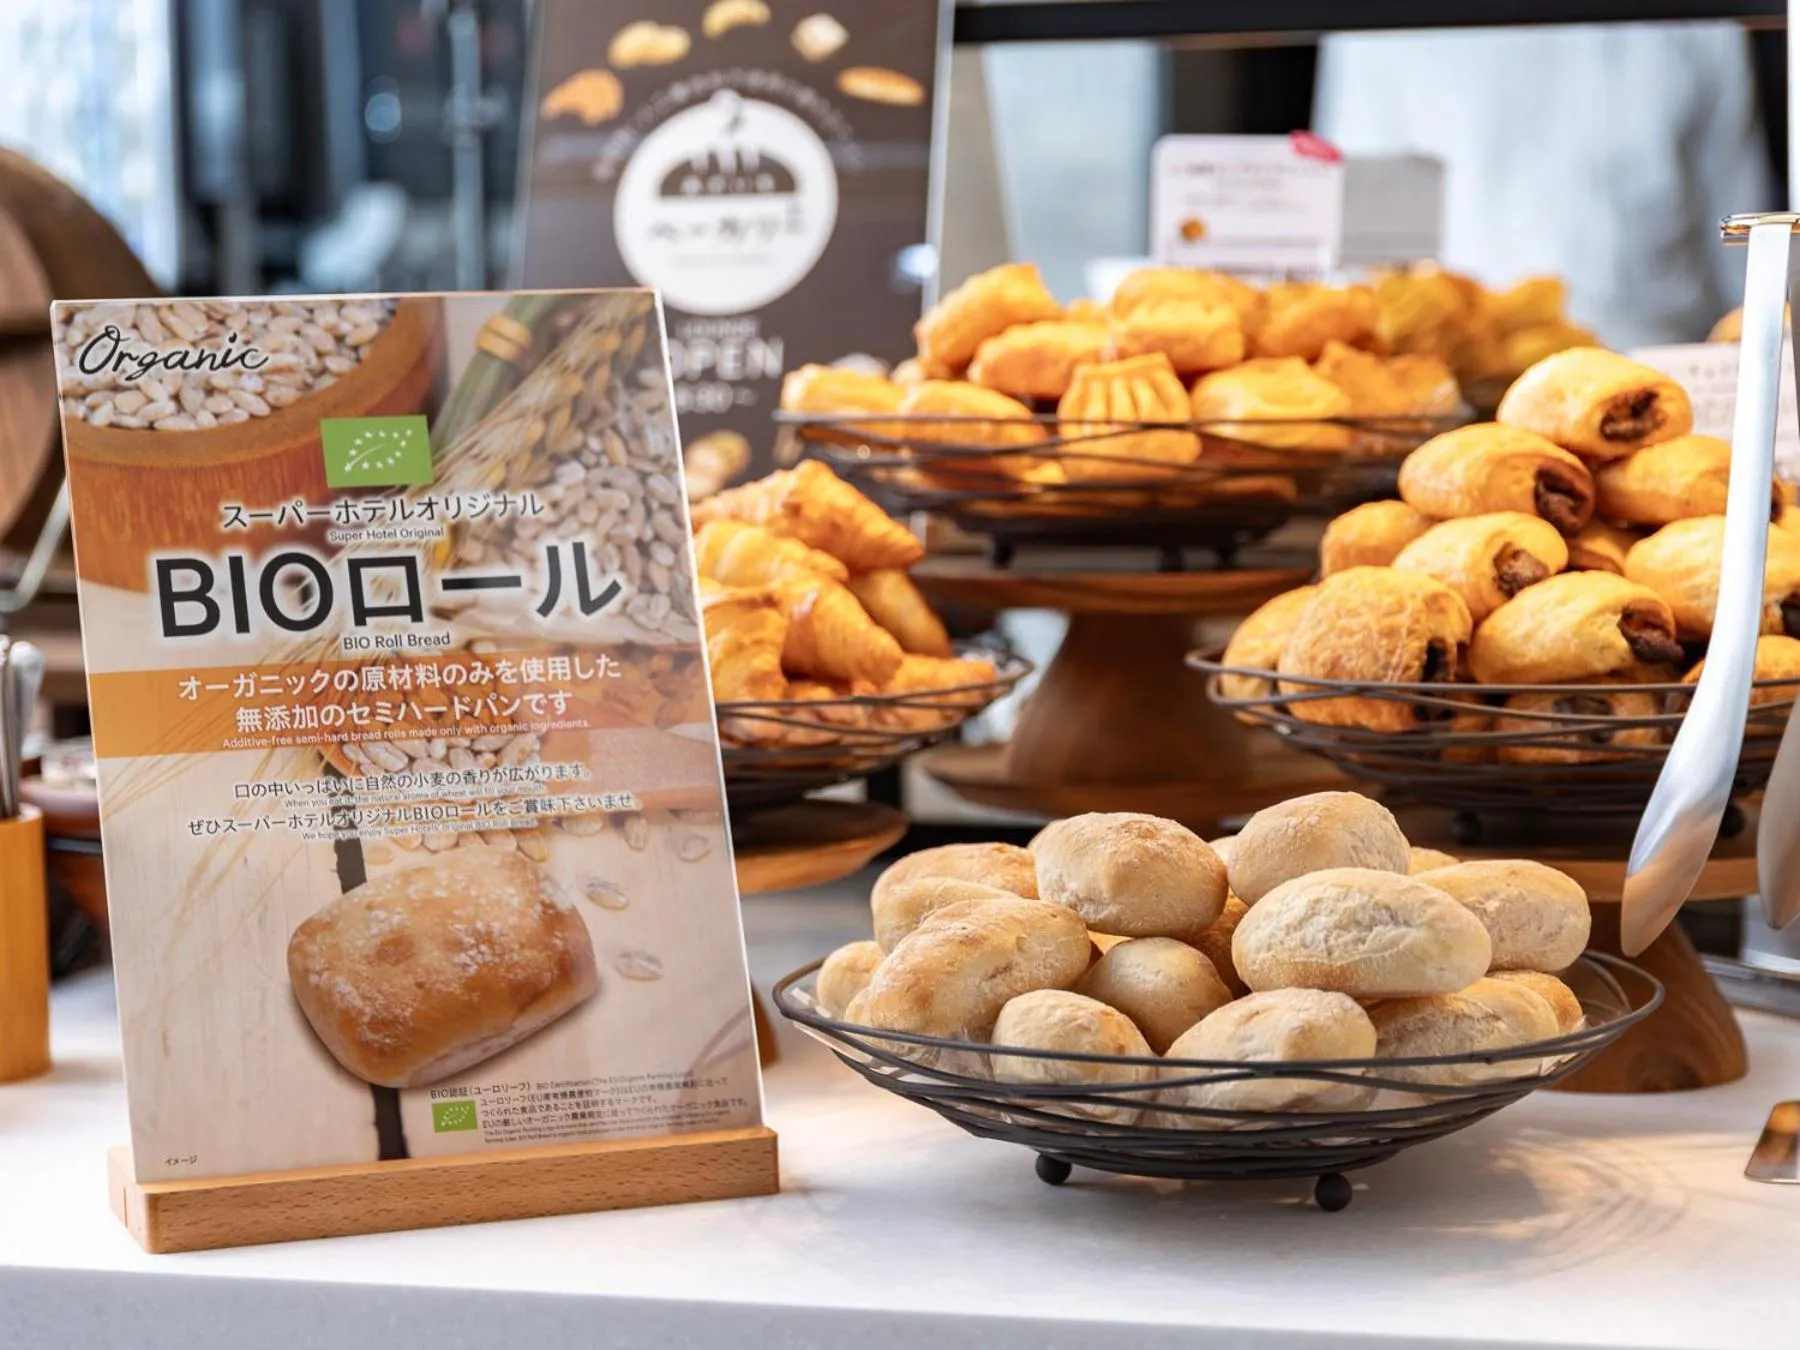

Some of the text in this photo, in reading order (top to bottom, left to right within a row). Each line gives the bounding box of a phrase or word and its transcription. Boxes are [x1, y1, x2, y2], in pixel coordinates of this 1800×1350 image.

[79, 325, 268, 381] Organic
[223, 493, 545, 528] スーパーホテルオリジナル
[330, 526, 445, 542] Super Hotel Original
[156, 541, 622, 637] BIOロール
[344, 633, 450, 649] BIO Roll Bread
[179, 653, 622, 701] オーガニックの原材料のみを使用した
[236, 690, 573, 733] 無添加のセミハードパンです
[223, 735, 293, 749] Additive-free
[295, 732, 348, 744] semi-hard
[351, 730, 381, 742] bread
[384, 729, 406, 739] rolls
[409, 727, 437, 737] made
[440, 725, 461, 737] only
[464, 723, 487, 734] with
[490, 722, 528, 735] organic
